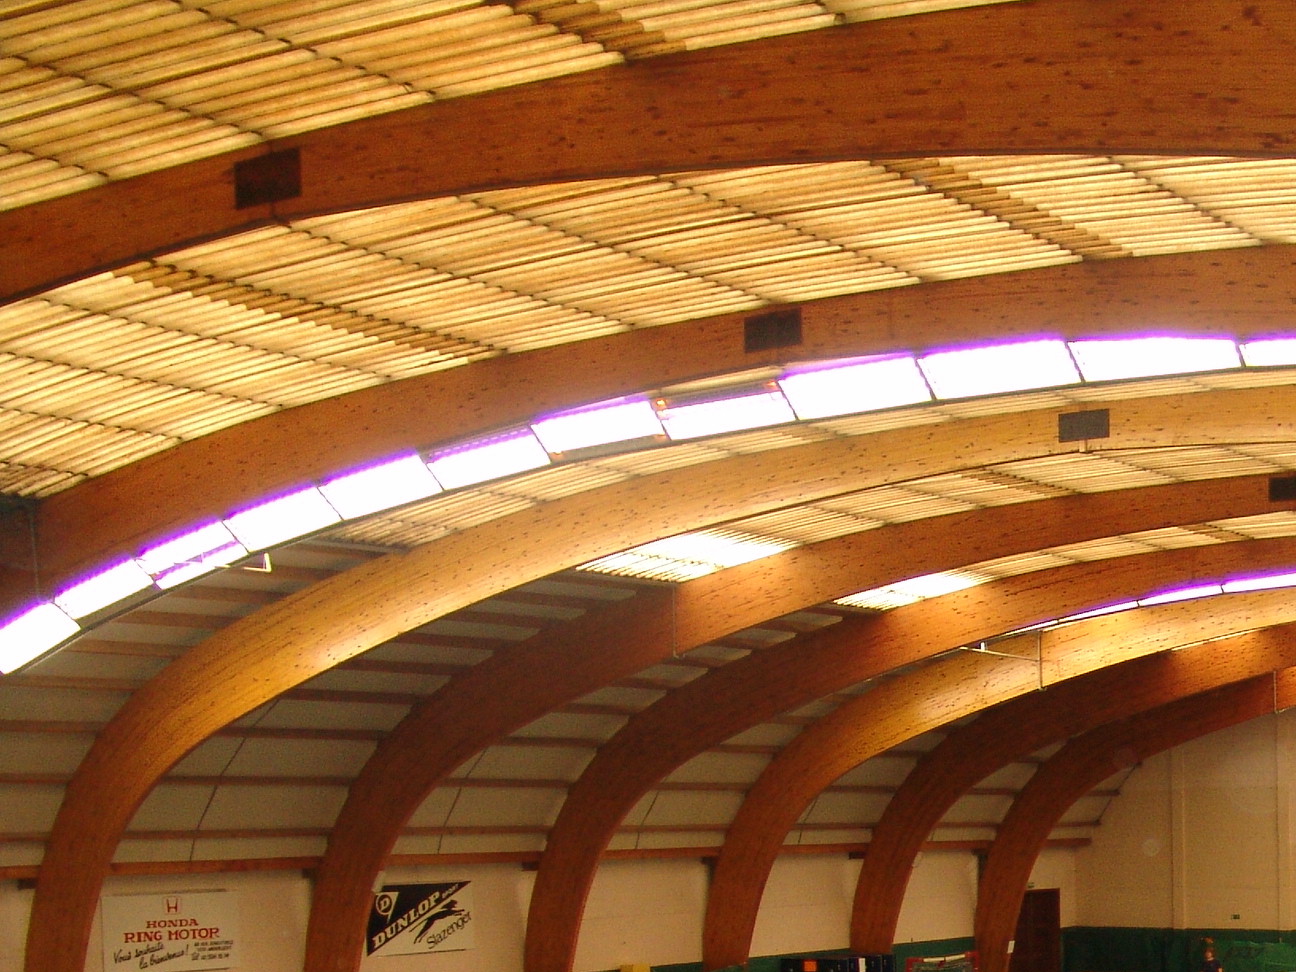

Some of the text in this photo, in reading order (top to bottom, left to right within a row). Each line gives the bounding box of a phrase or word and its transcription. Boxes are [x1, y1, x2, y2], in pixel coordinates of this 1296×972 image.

[146, 919, 198, 929] HONDA
[372, 891, 440, 948] DUNLOP
[426, 911, 472, 949] Slazenger
[124, 928, 220, 943] RING MOTOR
